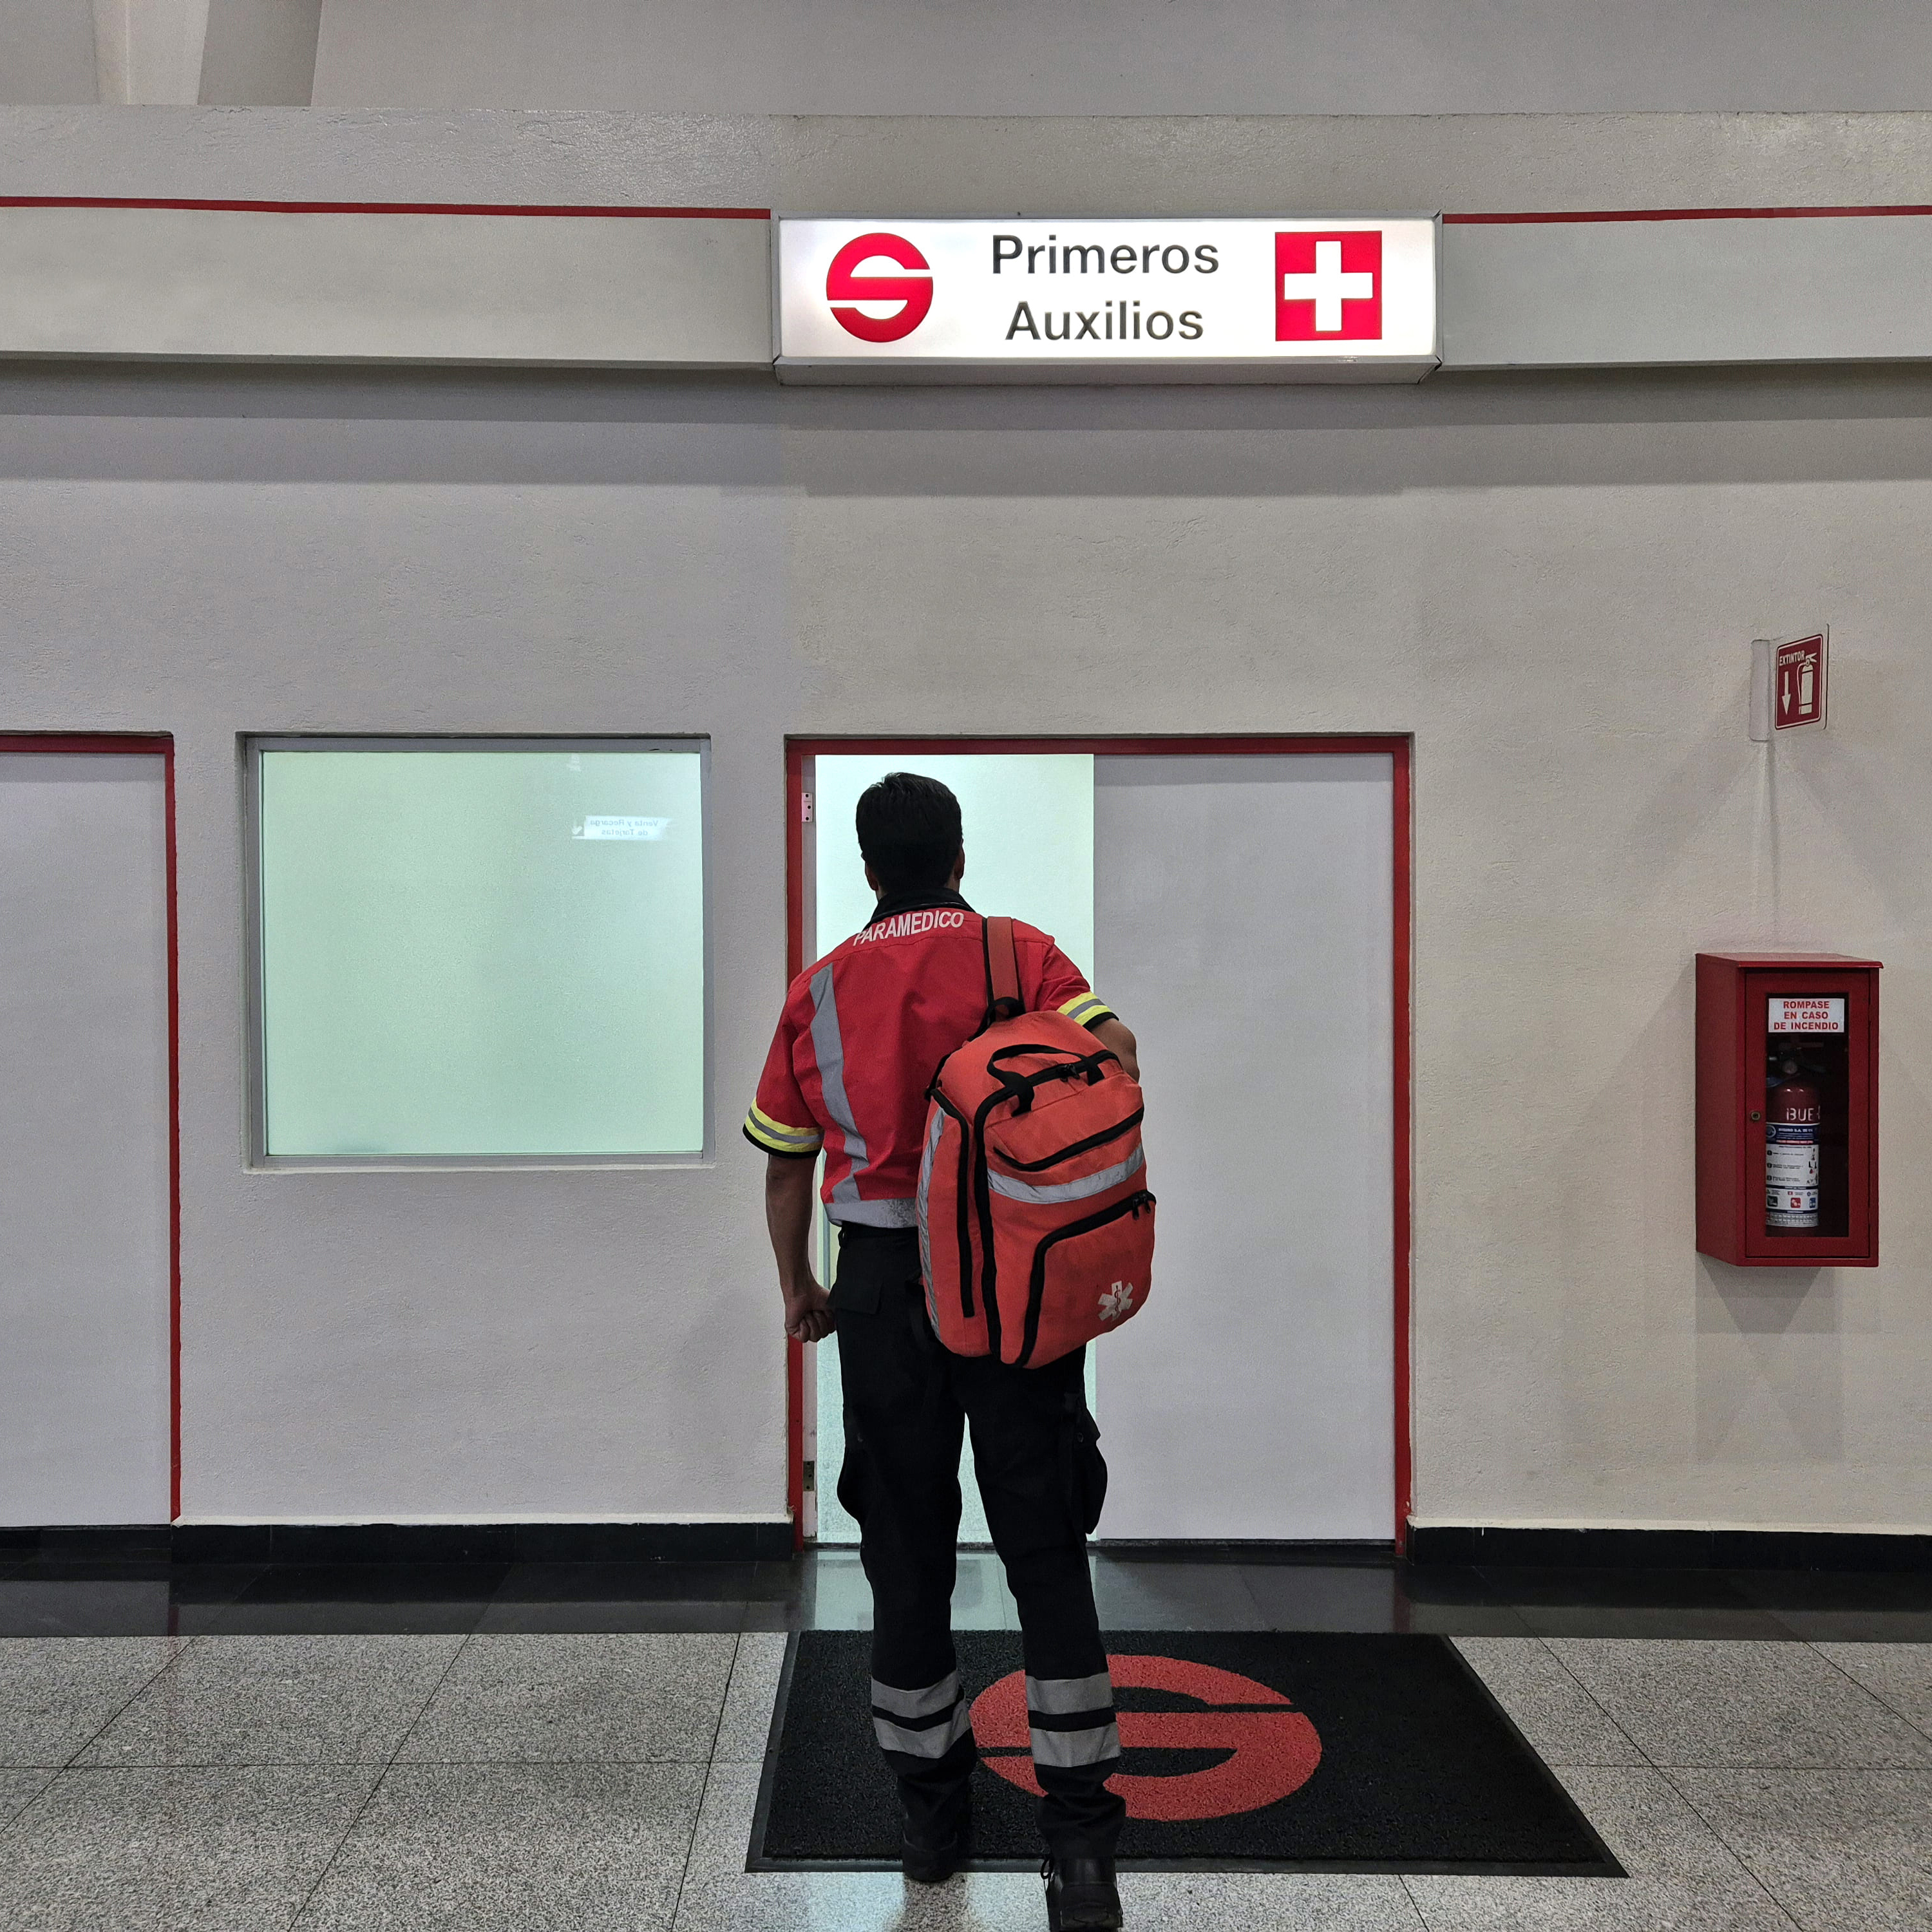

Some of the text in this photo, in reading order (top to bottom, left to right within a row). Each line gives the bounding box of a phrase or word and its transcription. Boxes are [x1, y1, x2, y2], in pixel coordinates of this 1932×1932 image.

[992, 234, 1218, 274] Primeros
[1005, 301, 1203, 341] Auxilios
[1779, 650, 1805, 666] EXTINTOR
[853, 910, 964, 947] PARAMEDICO
[1783, 1001, 1830, 1009] ROMPASE
[1784, 1011, 1828, 1019] EN CASO
[1791, 1022, 1839, 1030] INCENDIO
